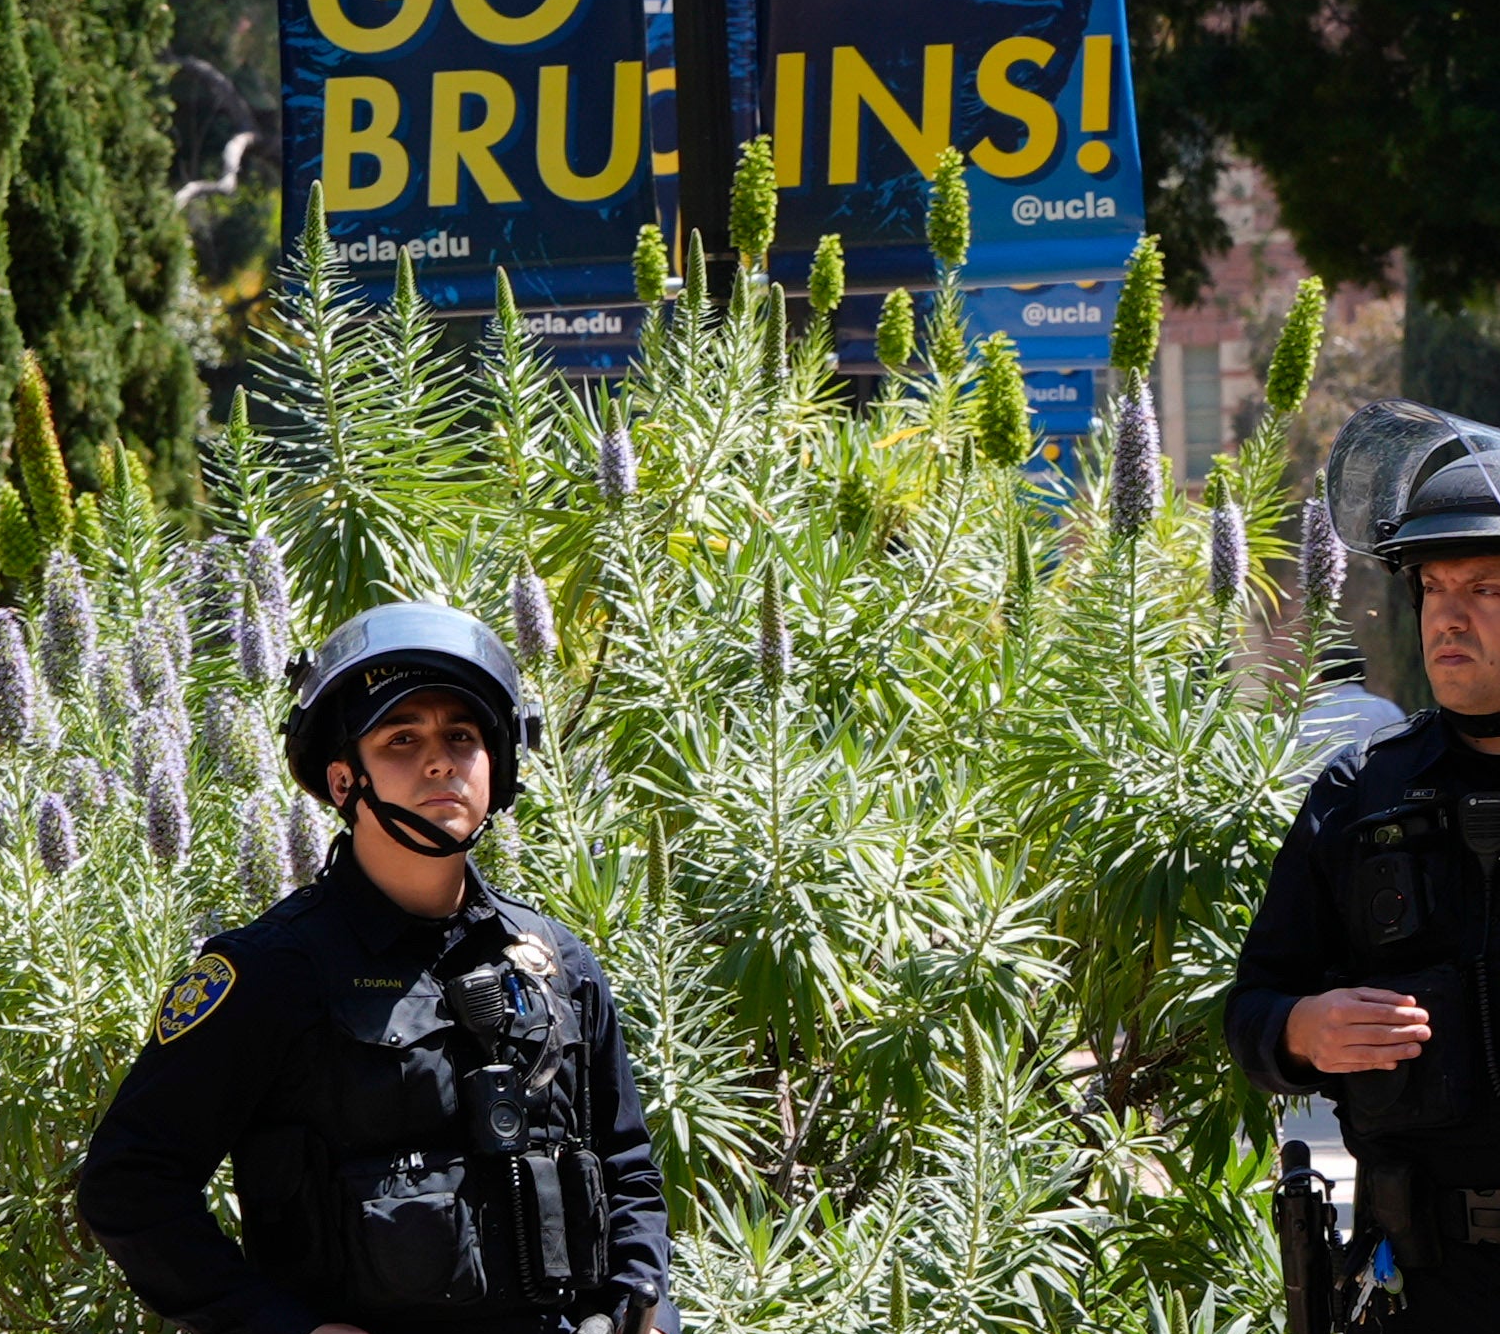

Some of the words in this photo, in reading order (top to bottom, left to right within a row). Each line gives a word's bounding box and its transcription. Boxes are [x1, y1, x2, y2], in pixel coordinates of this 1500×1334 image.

[773, 34, 1112, 188] INS!
[321, 61, 643, 212] BRU
[1012, 191, 1116, 225] @ucla
[333, 231, 470, 263] uclaedu
[1022, 302, 1102, 326] @ucla
